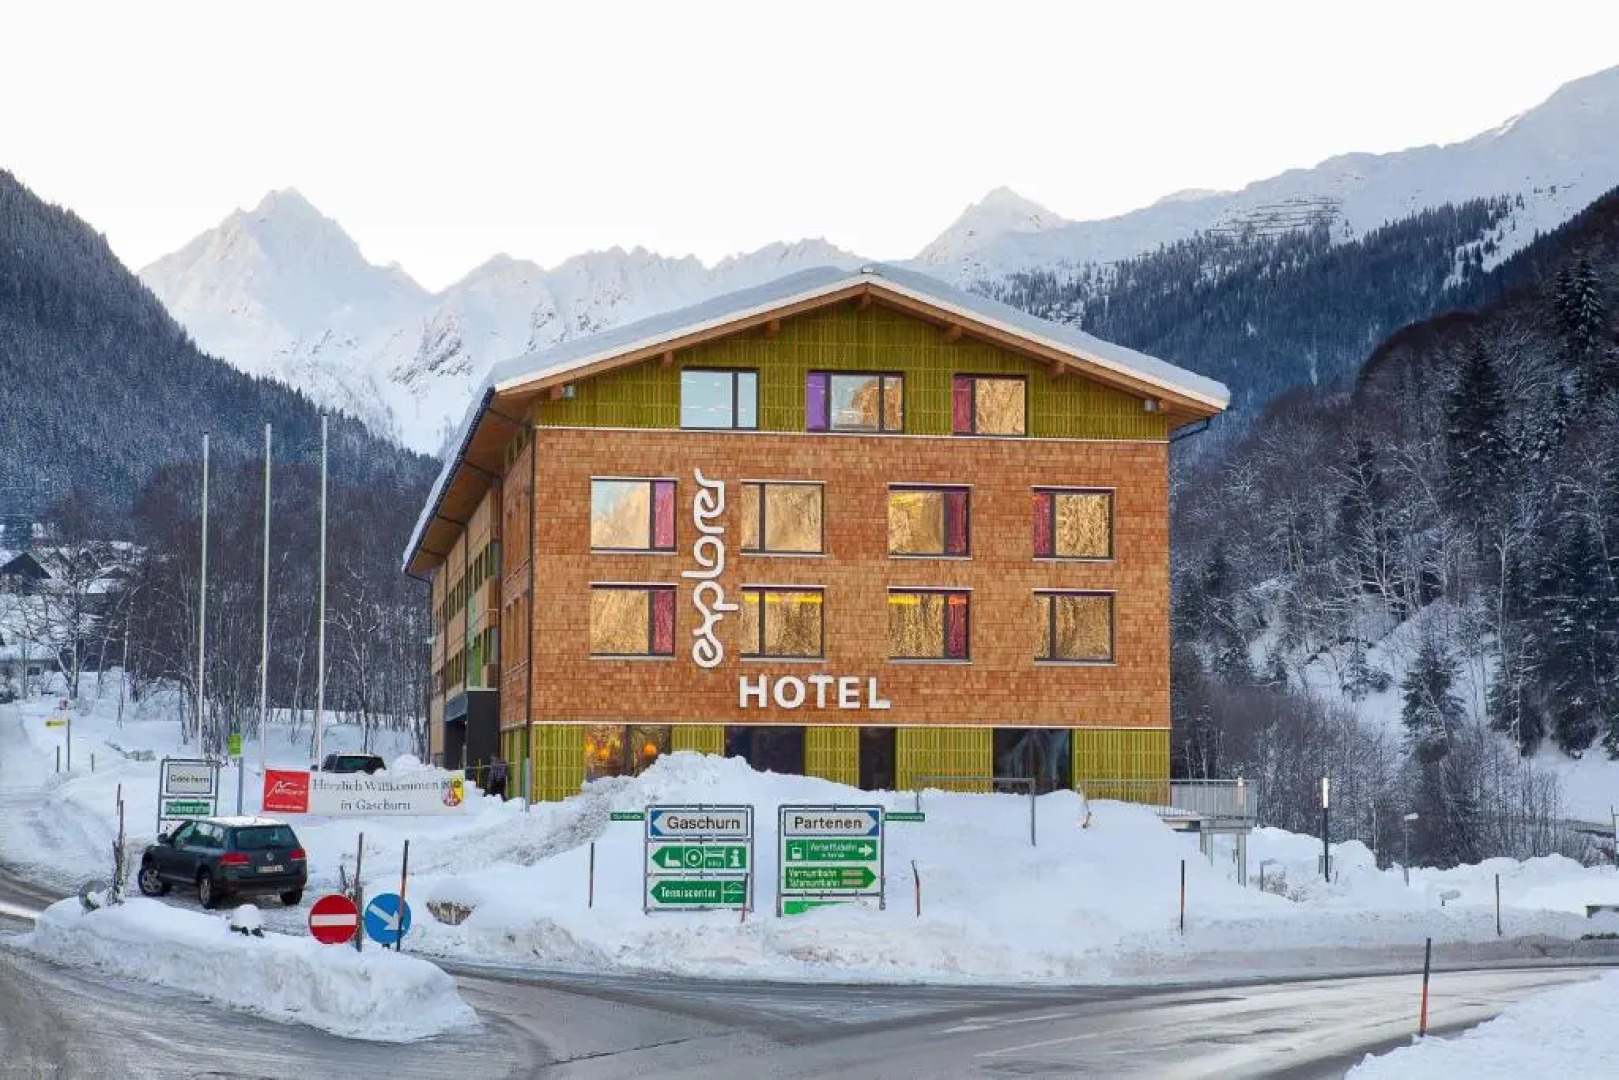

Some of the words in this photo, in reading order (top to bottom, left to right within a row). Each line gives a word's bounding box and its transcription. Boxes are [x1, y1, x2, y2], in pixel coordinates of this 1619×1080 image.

[681, 468, 739, 668] explorer
[739, 674, 891, 709] HOTEL
[312, 779, 362, 791] Herzlich
[364, 780, 438, 791] Willkommen
[341, 800, 352, 810] in
[356, 799, 411, 811] Gaschurn
[666, 816, 741, 829] Gaschurn
[794, 816, 863, 829] Partenen
[661, 887, 717, 898] Tenniscenter
